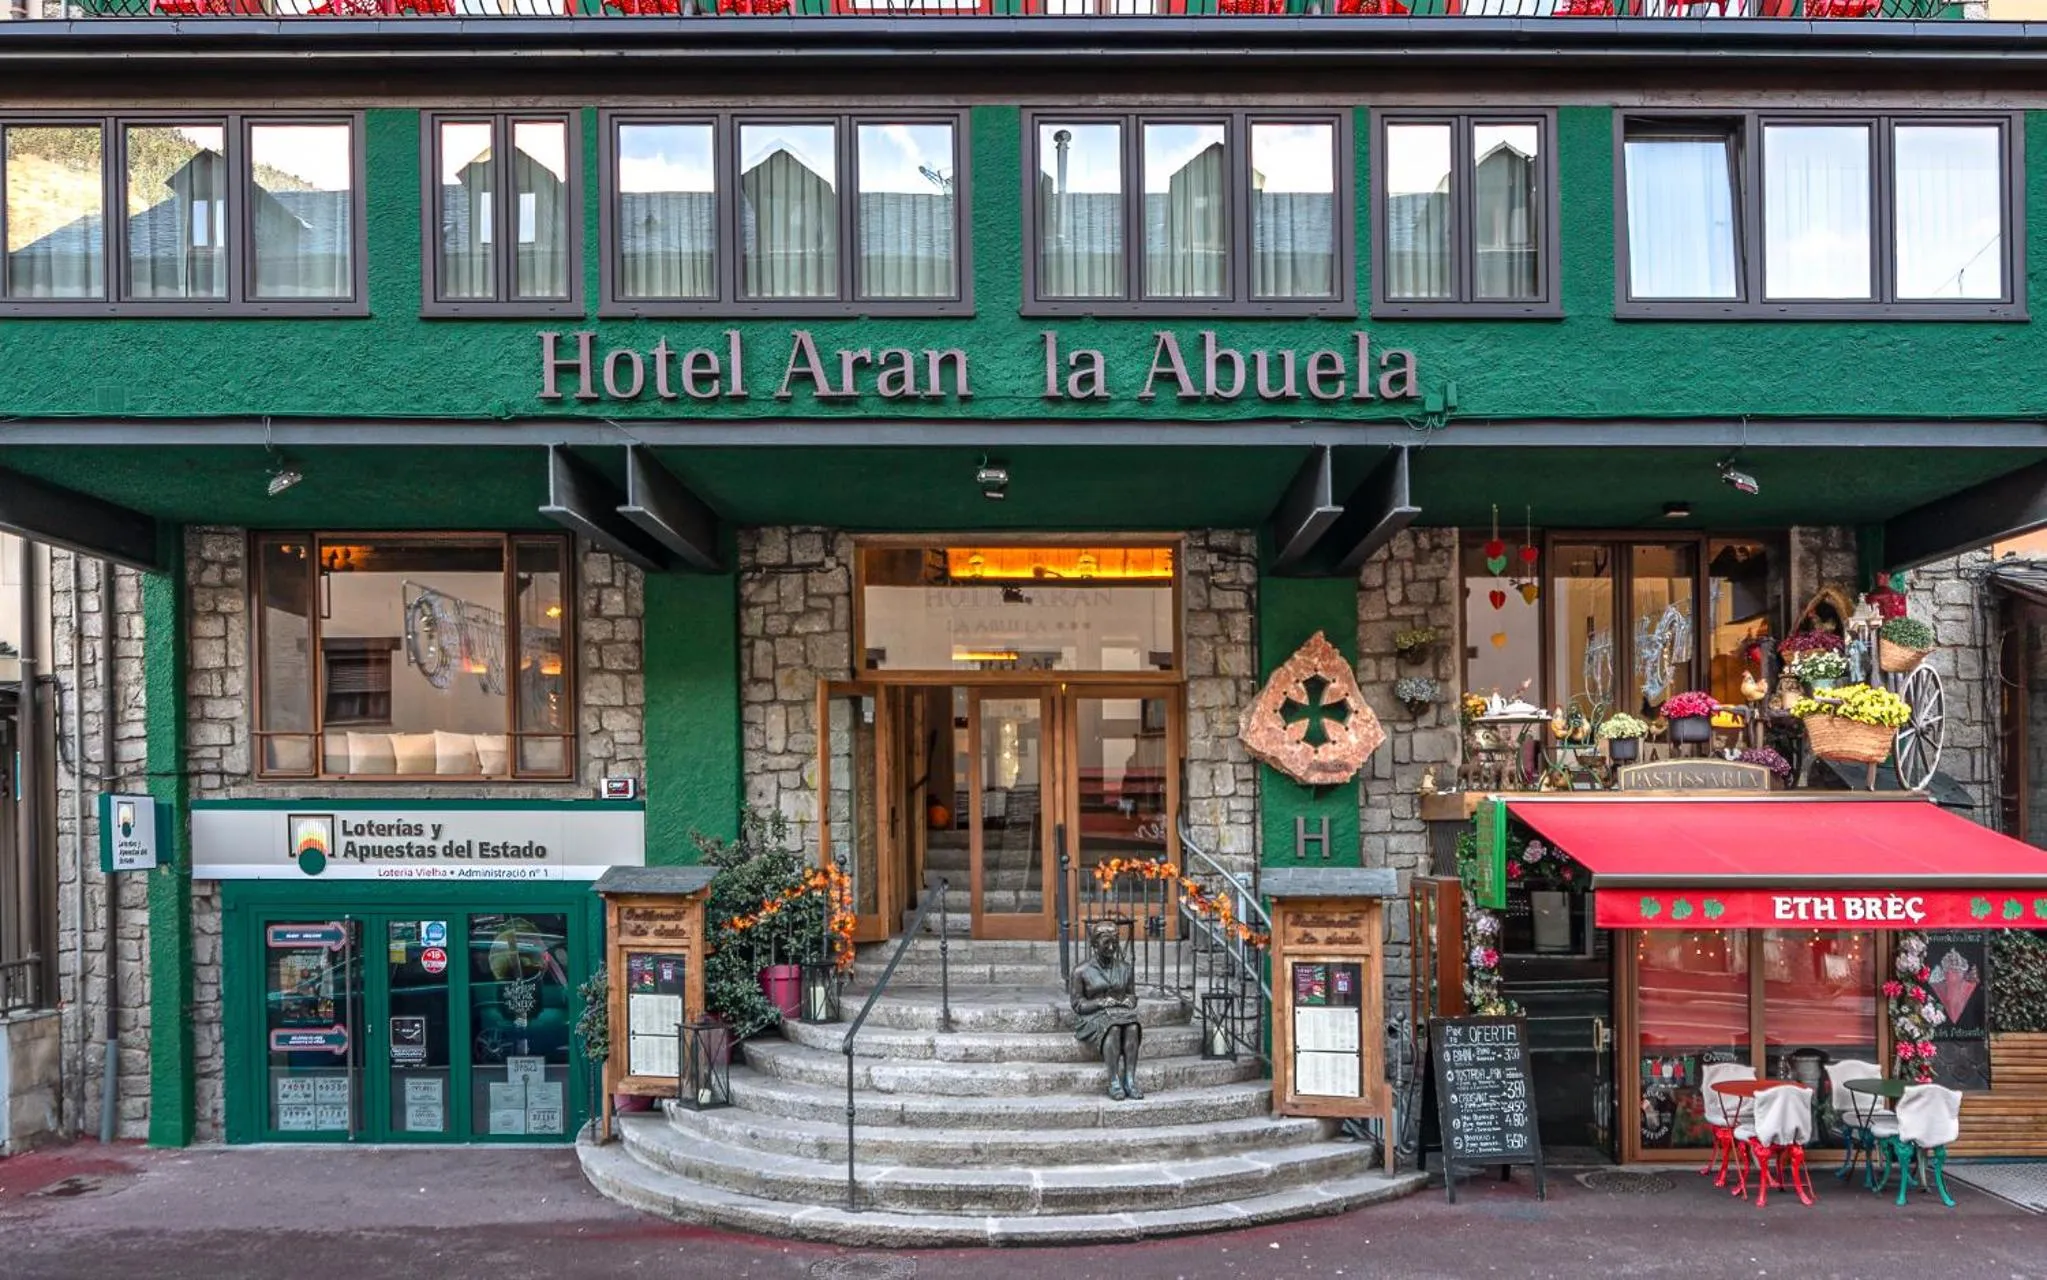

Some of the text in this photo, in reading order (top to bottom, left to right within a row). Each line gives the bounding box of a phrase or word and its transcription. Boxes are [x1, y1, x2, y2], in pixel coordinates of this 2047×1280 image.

[537, 329, 1423, 399] Hotel Aran la Abuela
[1631, 770, 1759, 788] PASTISSARIA
[341, 818, 443, 841] Loterías y
[1296, 816, 1330, 858] H
[343, 840, 547, 862] Apuestas del Estado
[1773, 896, 1838, 920] ETH
[1469, 1024, 1517, 1042] OFERTA
